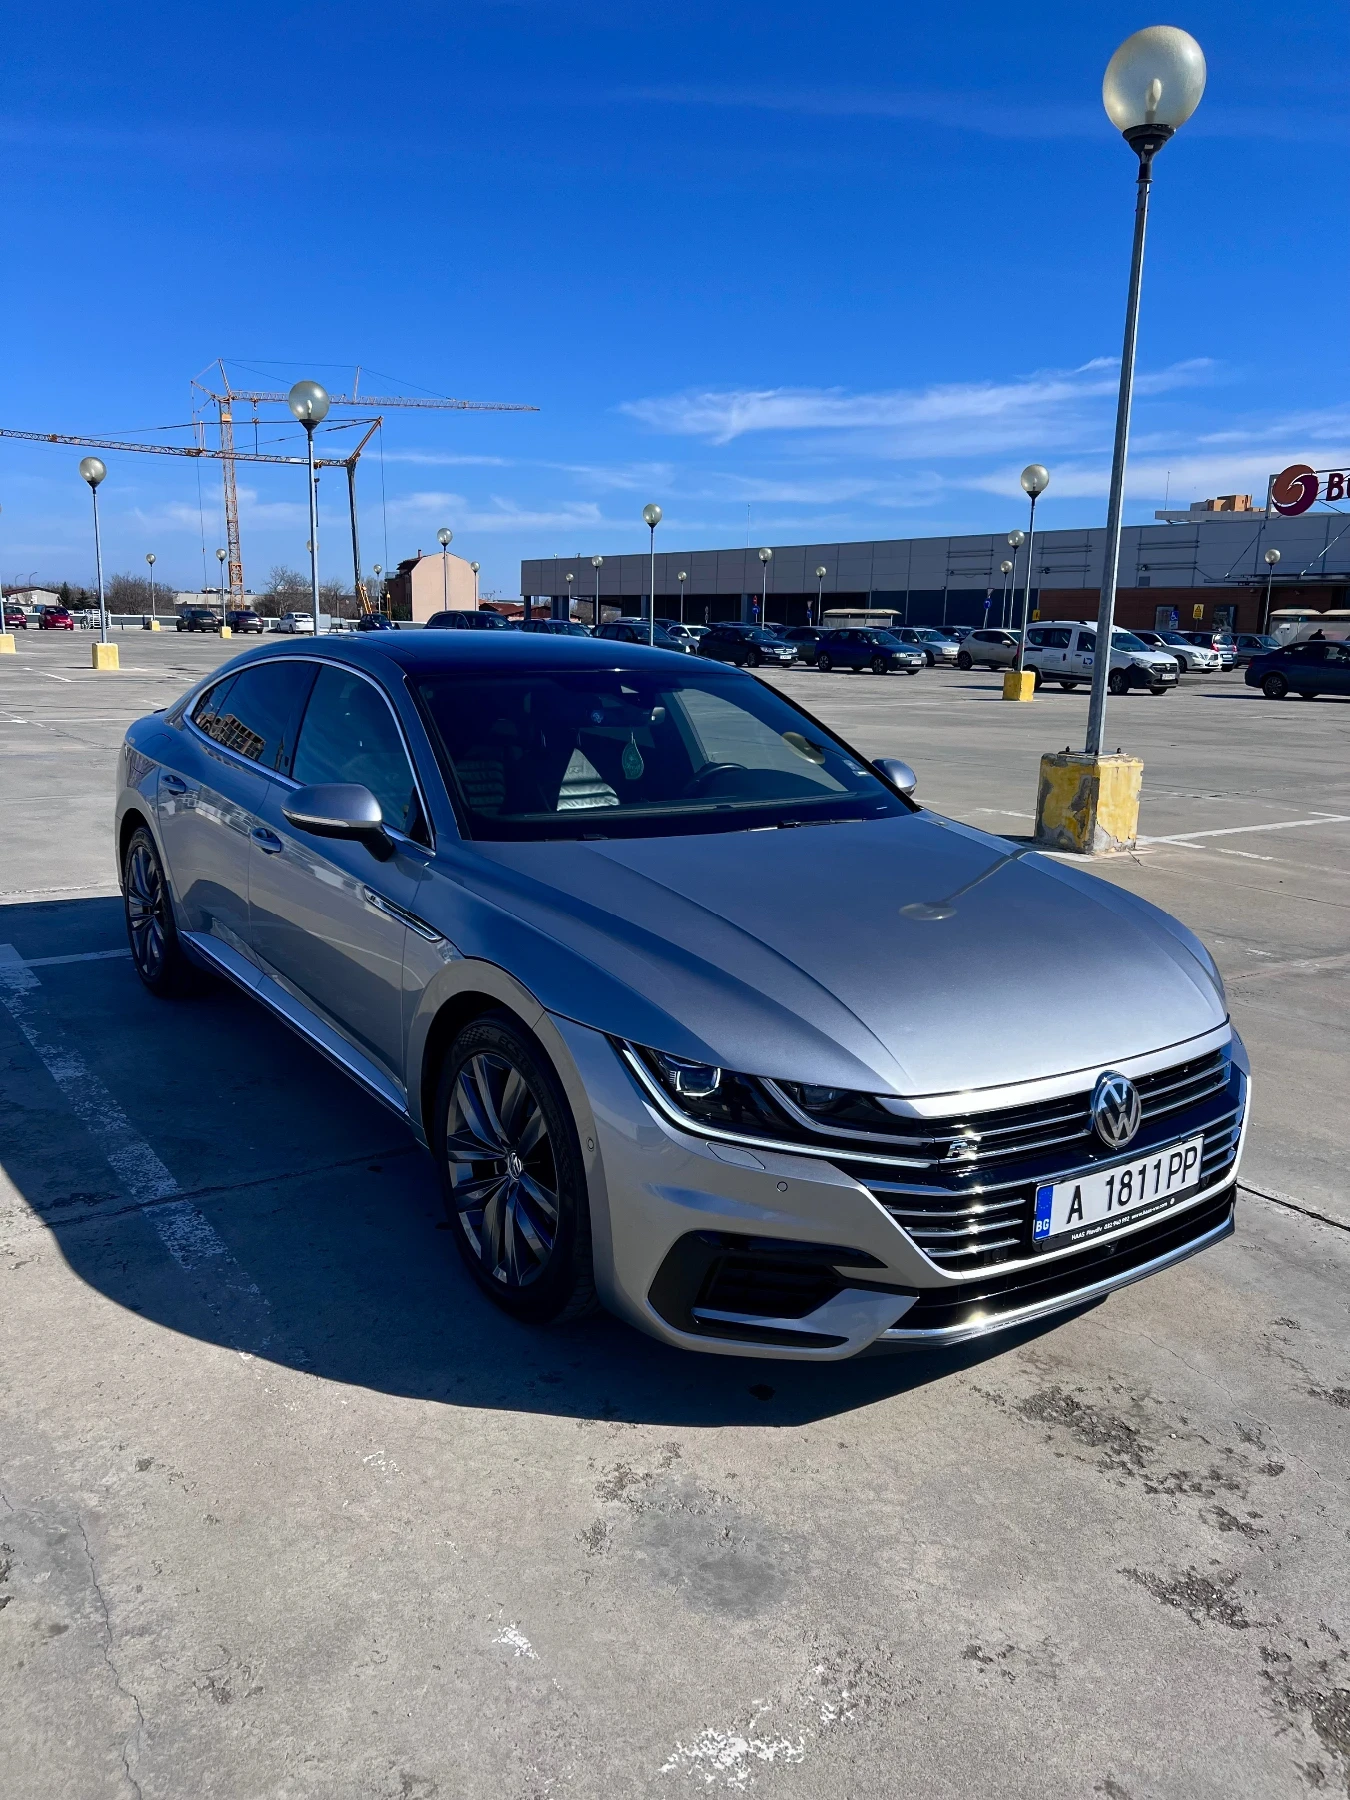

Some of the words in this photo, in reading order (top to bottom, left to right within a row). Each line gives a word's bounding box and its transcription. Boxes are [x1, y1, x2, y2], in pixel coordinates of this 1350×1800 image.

[1326, 473, 1350, 501] B
[1066, 1184, 1084, 1225] A
[1035, 1219, 1050, 1233] BG
[1071, 1231, 1085, 1241] HAAS
